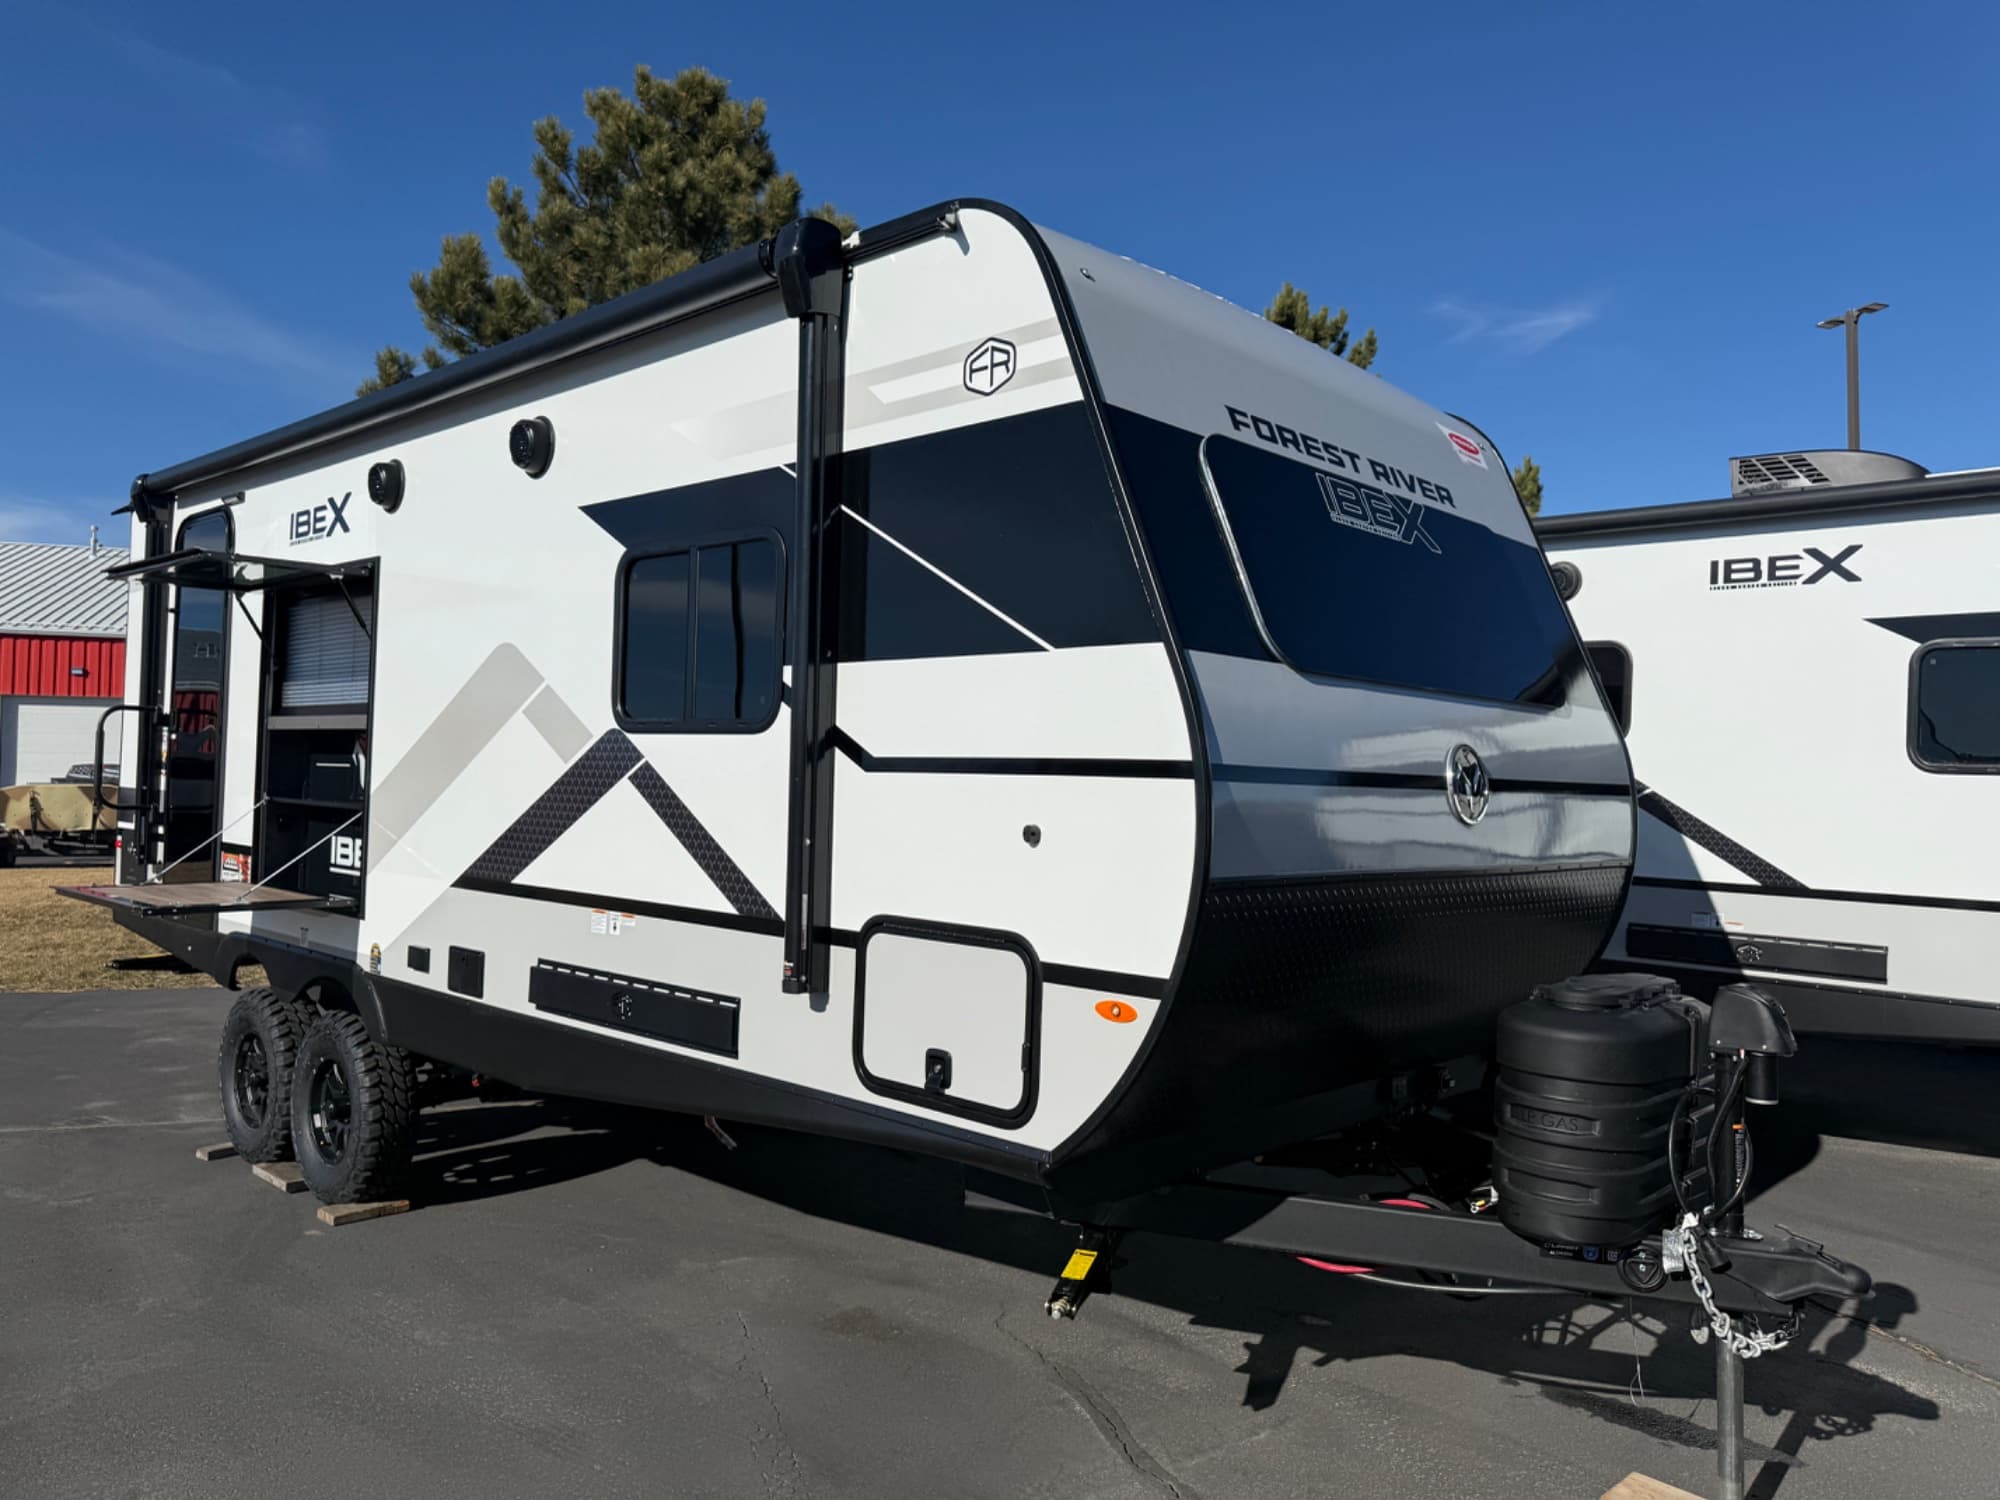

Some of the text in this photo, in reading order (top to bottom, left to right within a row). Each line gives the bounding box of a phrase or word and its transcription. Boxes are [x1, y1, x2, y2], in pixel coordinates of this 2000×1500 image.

[968, 344, 1011, 388] FR
[1223, 404, 1457, 509] FOREST RIVER
[289, 491, 352, 541] IBEX
[1315, 472, 1442, 554] IBEX
[1709, 544, 1864, 586] IBEX
[1541, 1113, 1578, 1132] GAS
